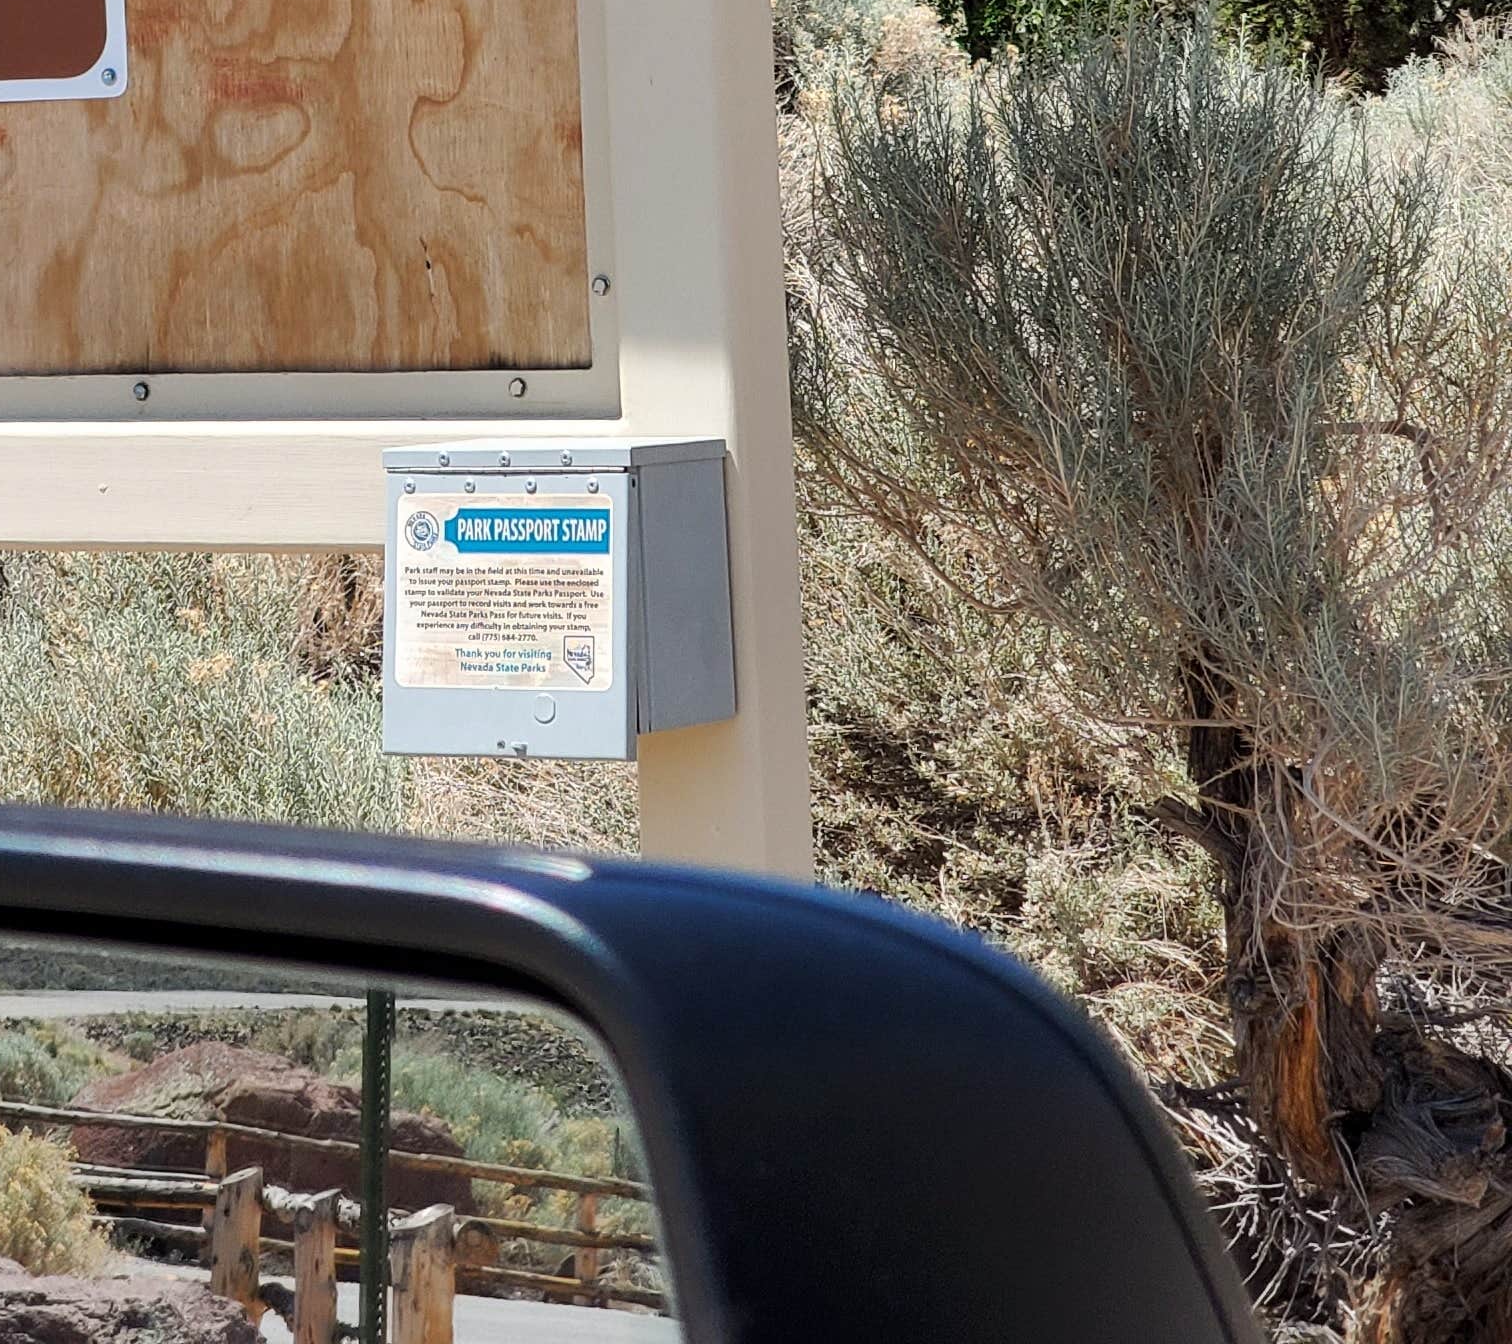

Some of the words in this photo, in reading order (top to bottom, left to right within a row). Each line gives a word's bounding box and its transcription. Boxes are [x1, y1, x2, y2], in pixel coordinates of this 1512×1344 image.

[458, 518, 491, 540] PARK
[495, 519, 559, 541] PASSPORT
[562, 520, 606, 542] STAMP
[456, 648, 482, 658] Thank
[485, 651, 500, 659] you
[503, 649, 517, 658] for
[518, 649, 552, 660] visiting
[461, 662, 493, 671] Nevada
[496, 663, 519, 672] State
[522, 663, 546, 672] Parks
